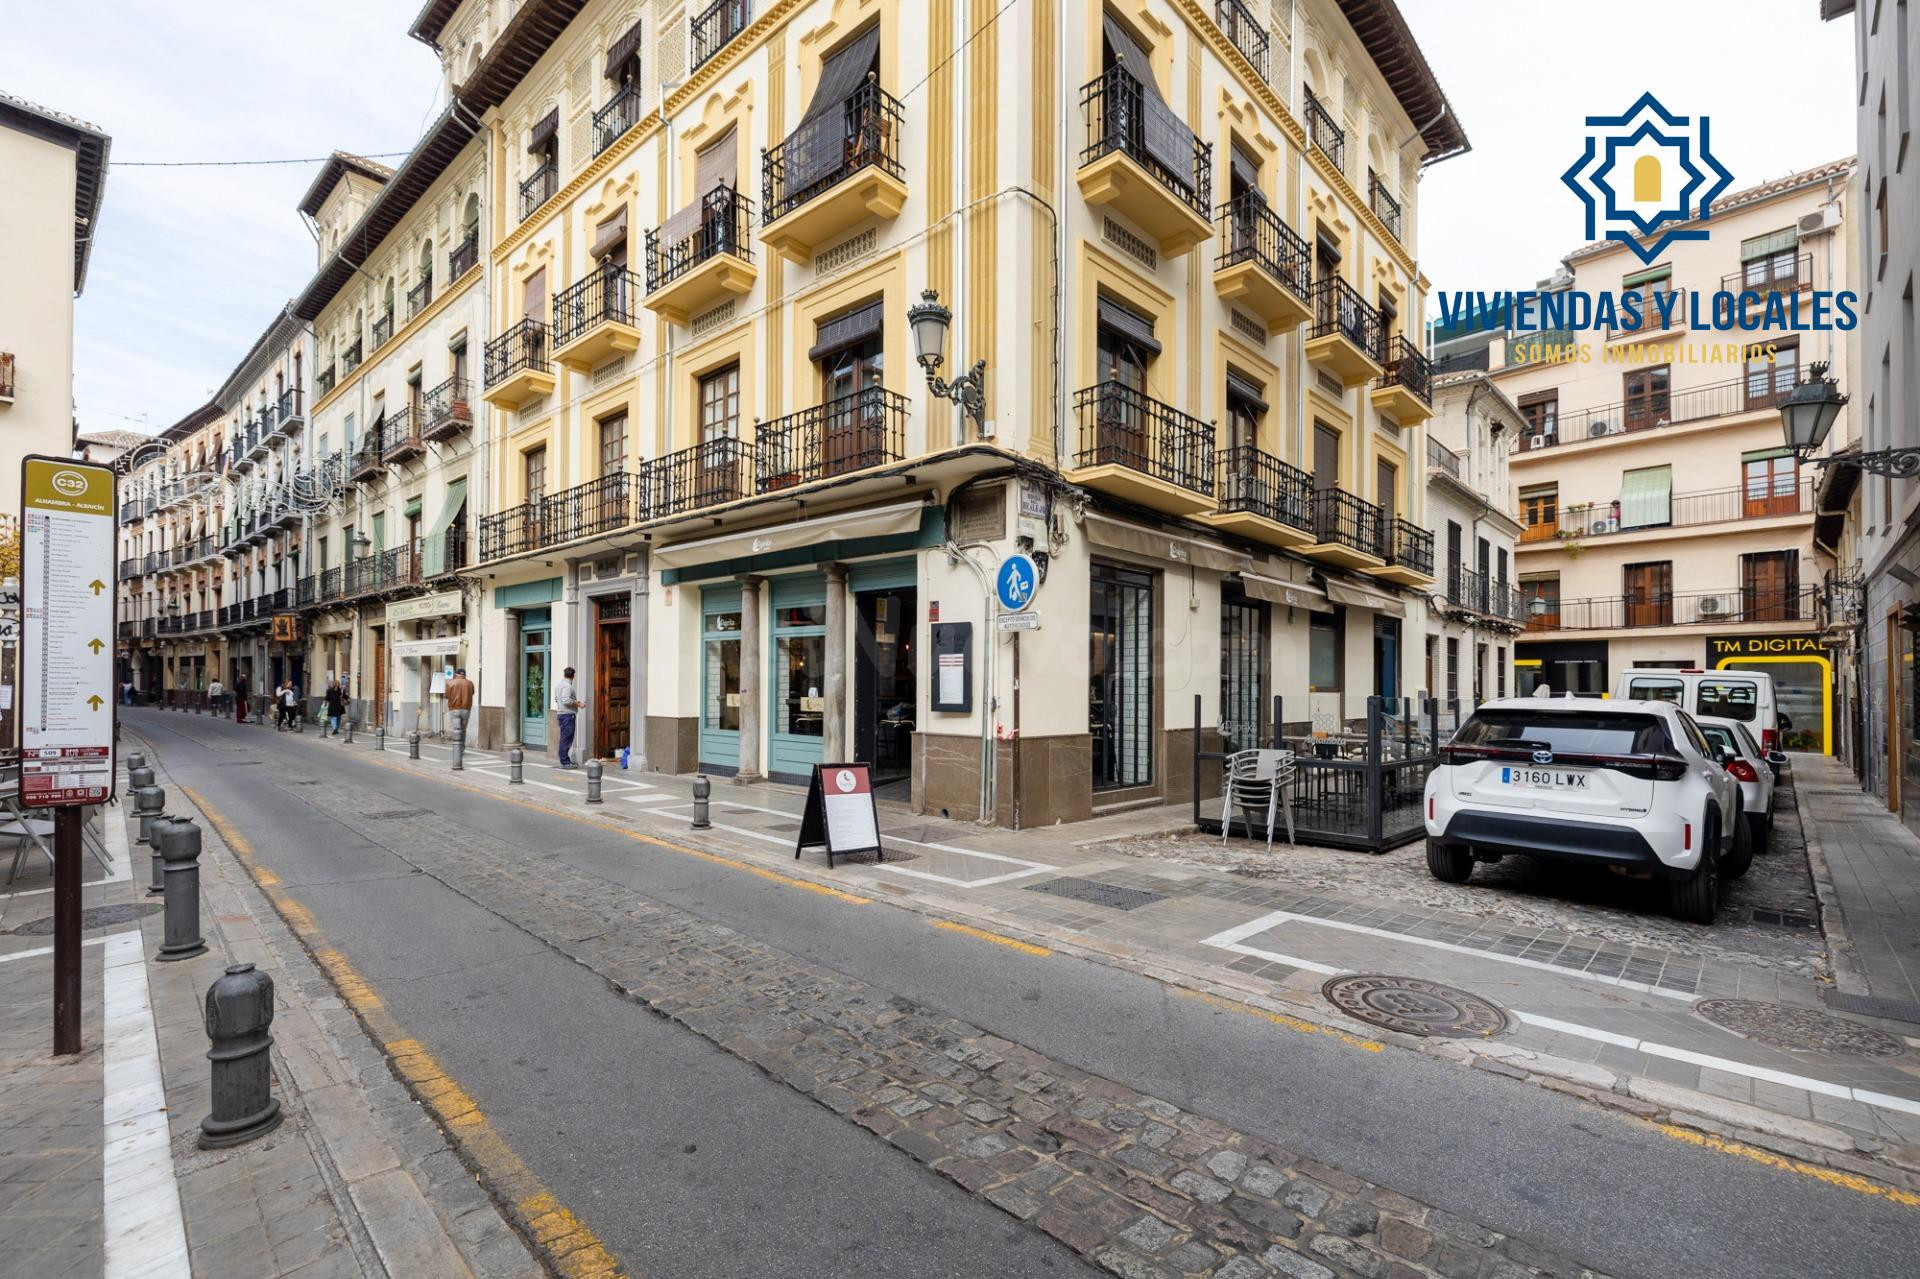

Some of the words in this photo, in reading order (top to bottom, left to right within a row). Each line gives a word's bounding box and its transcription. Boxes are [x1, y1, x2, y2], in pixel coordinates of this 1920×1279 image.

[57, 478, 84, 489] C32
[34, 498, 71, 507] ALHAMBRA
[1713, 640, 1741, 653] TM
[1748, 638, 1829, 652] DIGITAL
[1513, 770, 1550, 784] 3160
[1556, 773, 1585, 787] LWX
